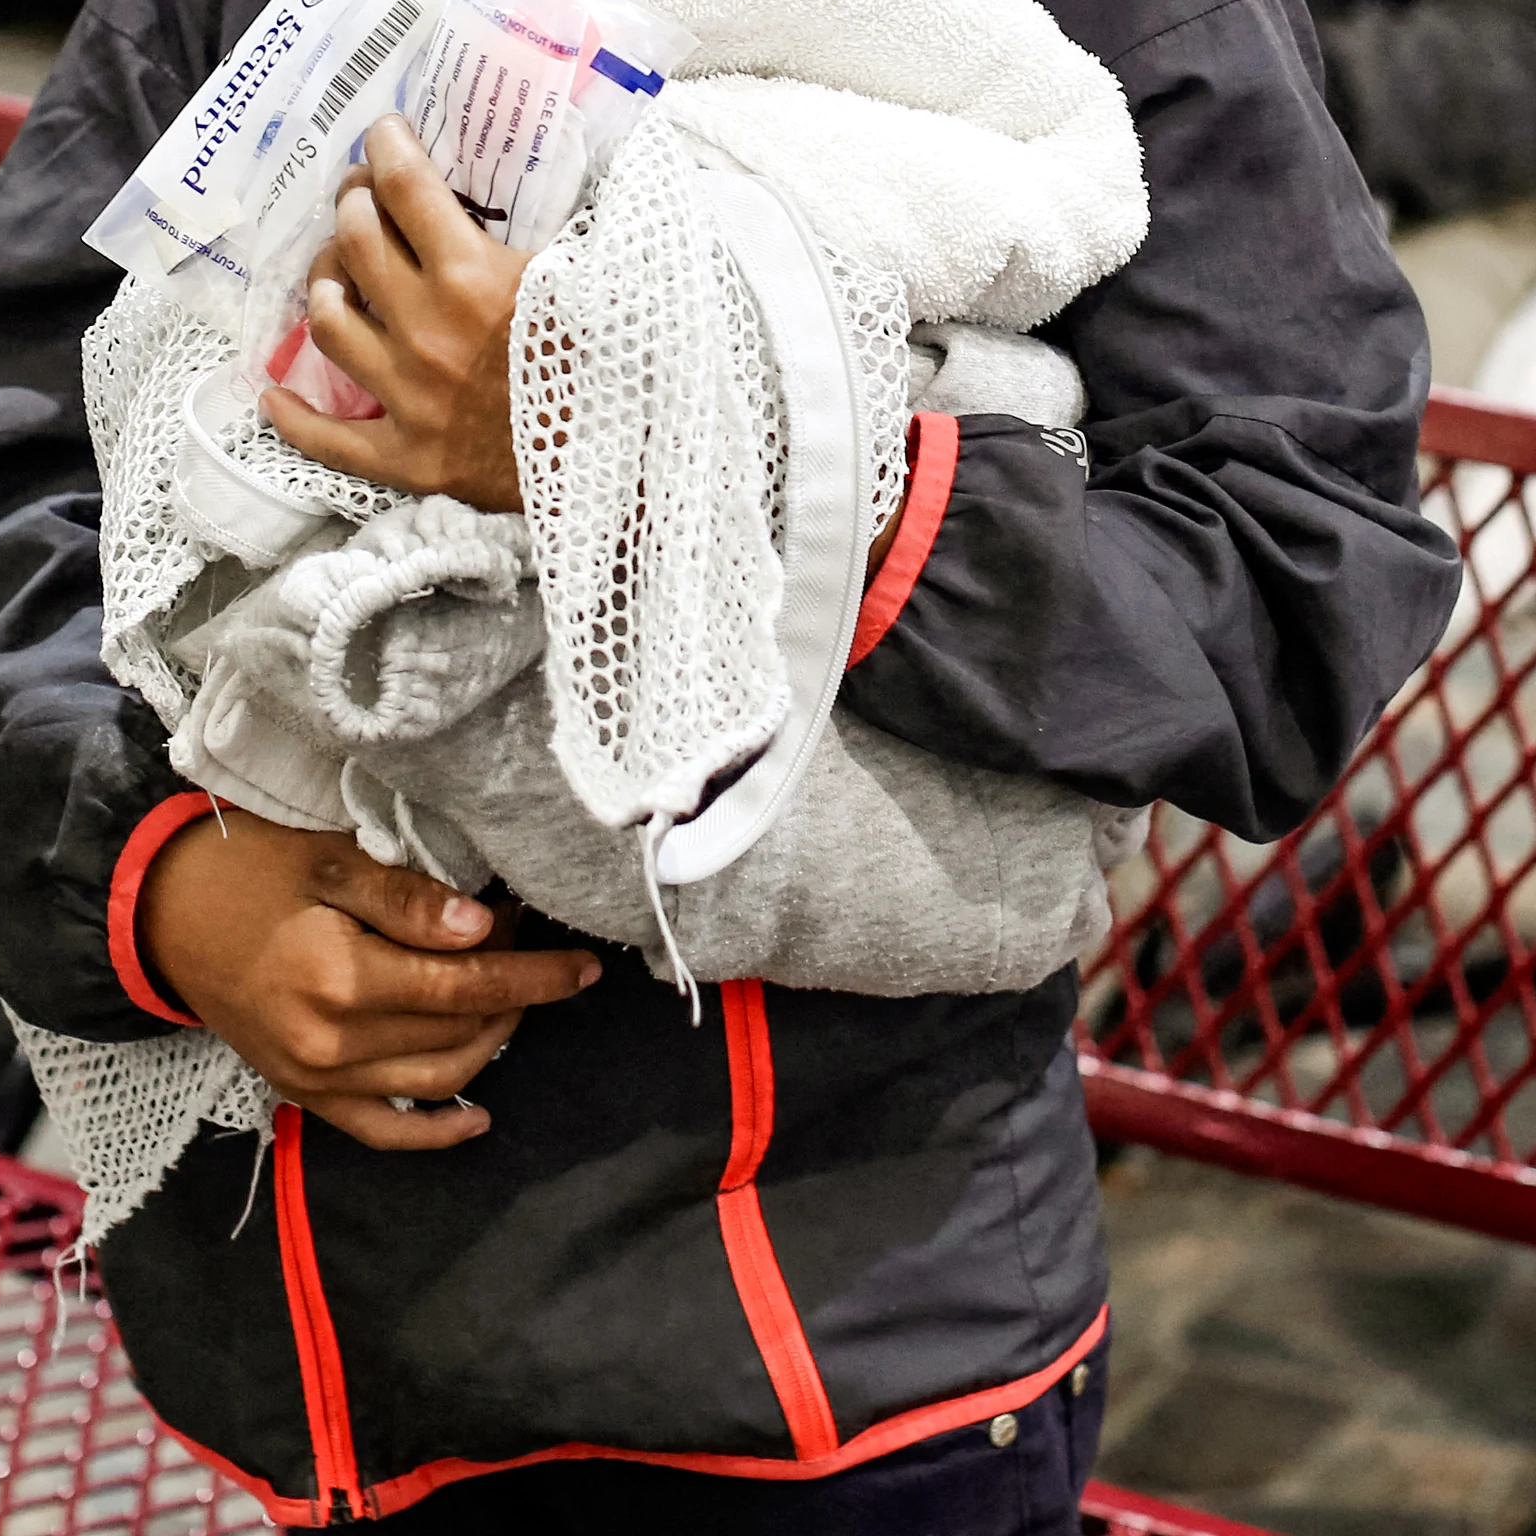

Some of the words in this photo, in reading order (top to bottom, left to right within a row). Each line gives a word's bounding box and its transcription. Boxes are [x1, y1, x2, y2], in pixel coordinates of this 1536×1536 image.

[494, 9, 507, 23] DO
[508, 19, 527, 34] NOT
[527, 31, 548, 46] CUT
[431, 29, 455, 85] Date/Time
[452, 42, 470, 84] Violator
[194, 8, 294, 141] Security
[463, 54, 488, 113] Witnessing
[488, 66, 508, 107] Seizing
[180, 17, 304, 195] Homeland
[430, 85, 438, 98] of
[517, 79, 530, 106] CBP
[540, 90, 559, 120] I.C.E.
[474, 108, 496, 159] Officer(s)
[508, 106, 522, 134] 6051
[501, 136, 515, 154] No.
[531, 124, 548, 153] Case
[524, 155, 539, 173] No.
[145, 208, 168, 230] OPEN
[168, 226, 180, 240] TO
[181, 234, 212, 257] HERE
[211, 254, 235, 270] CUT
